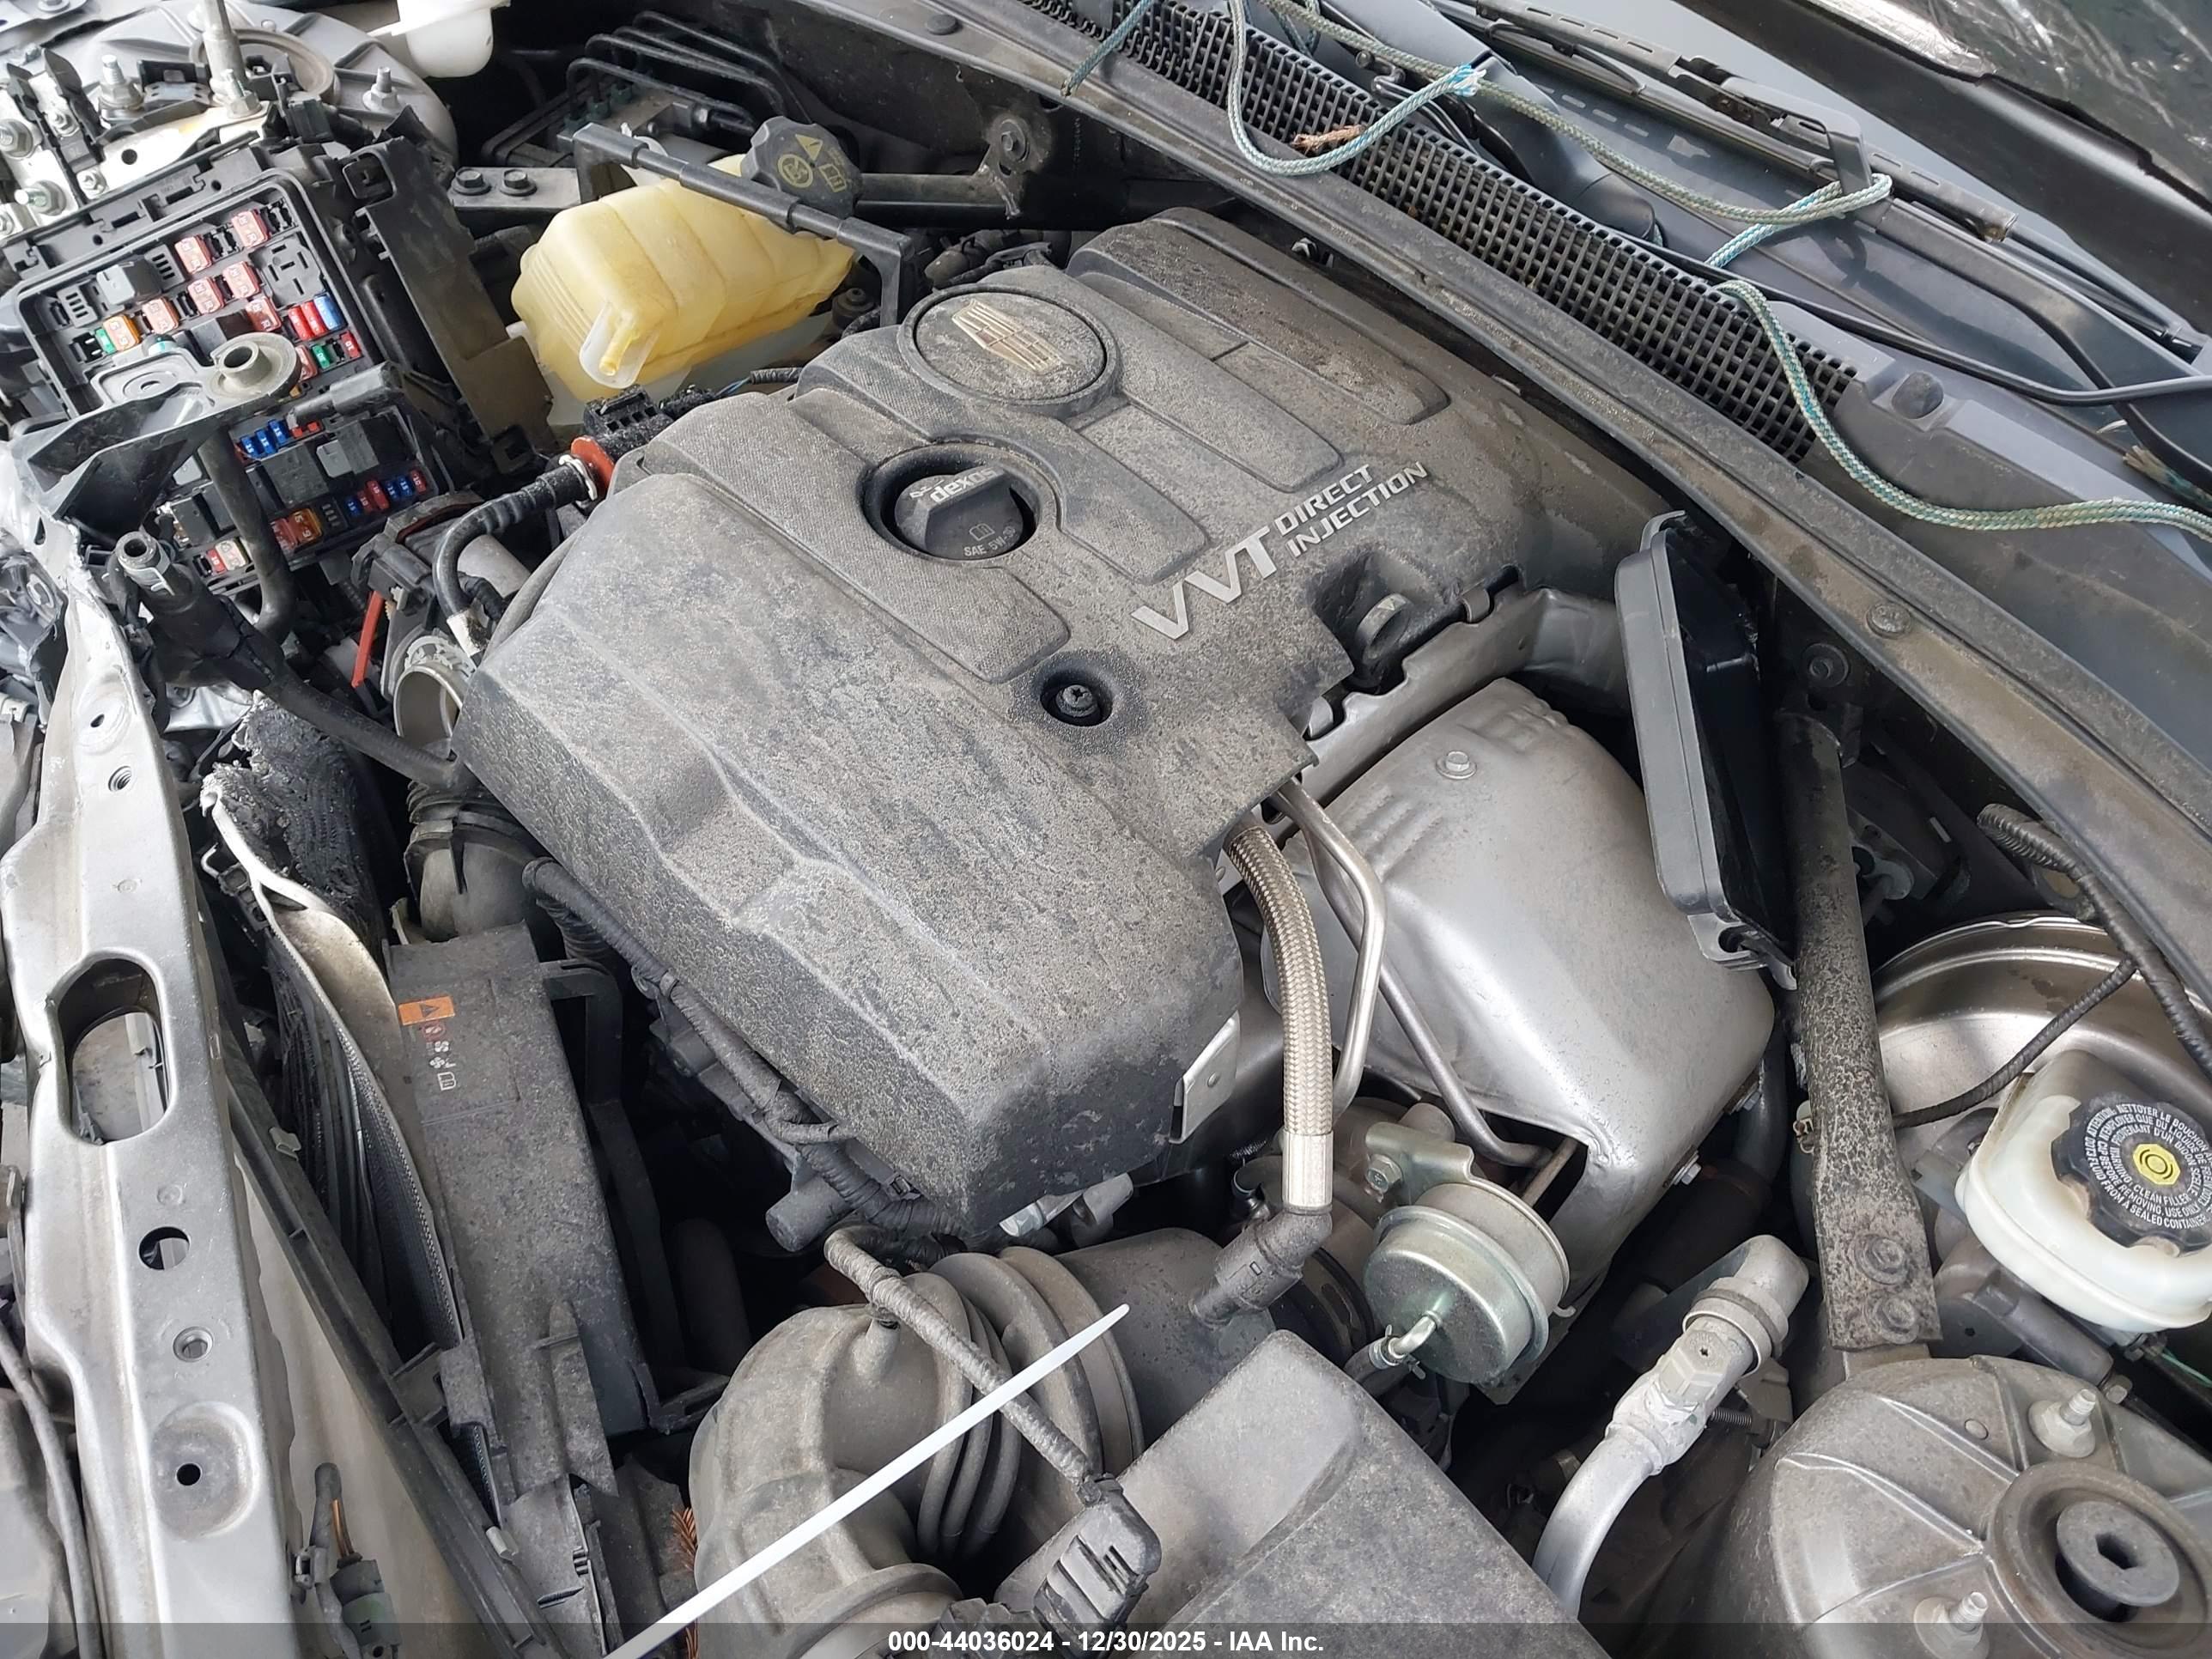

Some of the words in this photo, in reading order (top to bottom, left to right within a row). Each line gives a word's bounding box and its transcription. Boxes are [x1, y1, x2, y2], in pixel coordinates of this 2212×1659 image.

[260, 437, 270, 448] 15
[274, 428, 283, 437] 15
[930, 468, 998, 503] dexos
[1274, 464, 1373, 537] DIRECT
[1285, 461, 1428, 558] INJECTION
[963, 544, 987, 556] SAE
[1131, 526, 1277, 641] VVT
[2116, 1103, 2158, 1117] NETTOYER
[2160, 1111, 2171, 1123] LE
[2172, 1118, 2209, 1152] BOUCHON
[2136, 1114, 2154, 1125] QUE
[2156, 1118, 2167, 1130] DU
[2168, 1126, 2199, 1153] LIQUIDE
[2195, 1153, 2207, 1164] DE
[2097, 1140, 2108, 1156] CAP
[2154, 1127, 2174, 1144] D'UN
[2174, 1140, 2197, 1166] BIDON
[2099, 1155, 2123, 1186] BEFORE
[2087, 1157, 2106, 1180] FLUID
[2100, 1179, 2125, 1204] FROM
[2122, 1200, 2130, 1209] A
[2130, 1204, 2162, 1226] SEALED
[2118, 1184, 2164, 1216] REMOVING.
[2133, 1184, 2162, 1204] CLEAN
[2163, 1193, 2191, 1206] FILLER
[2165, 1206, 2183, 1218] USE
